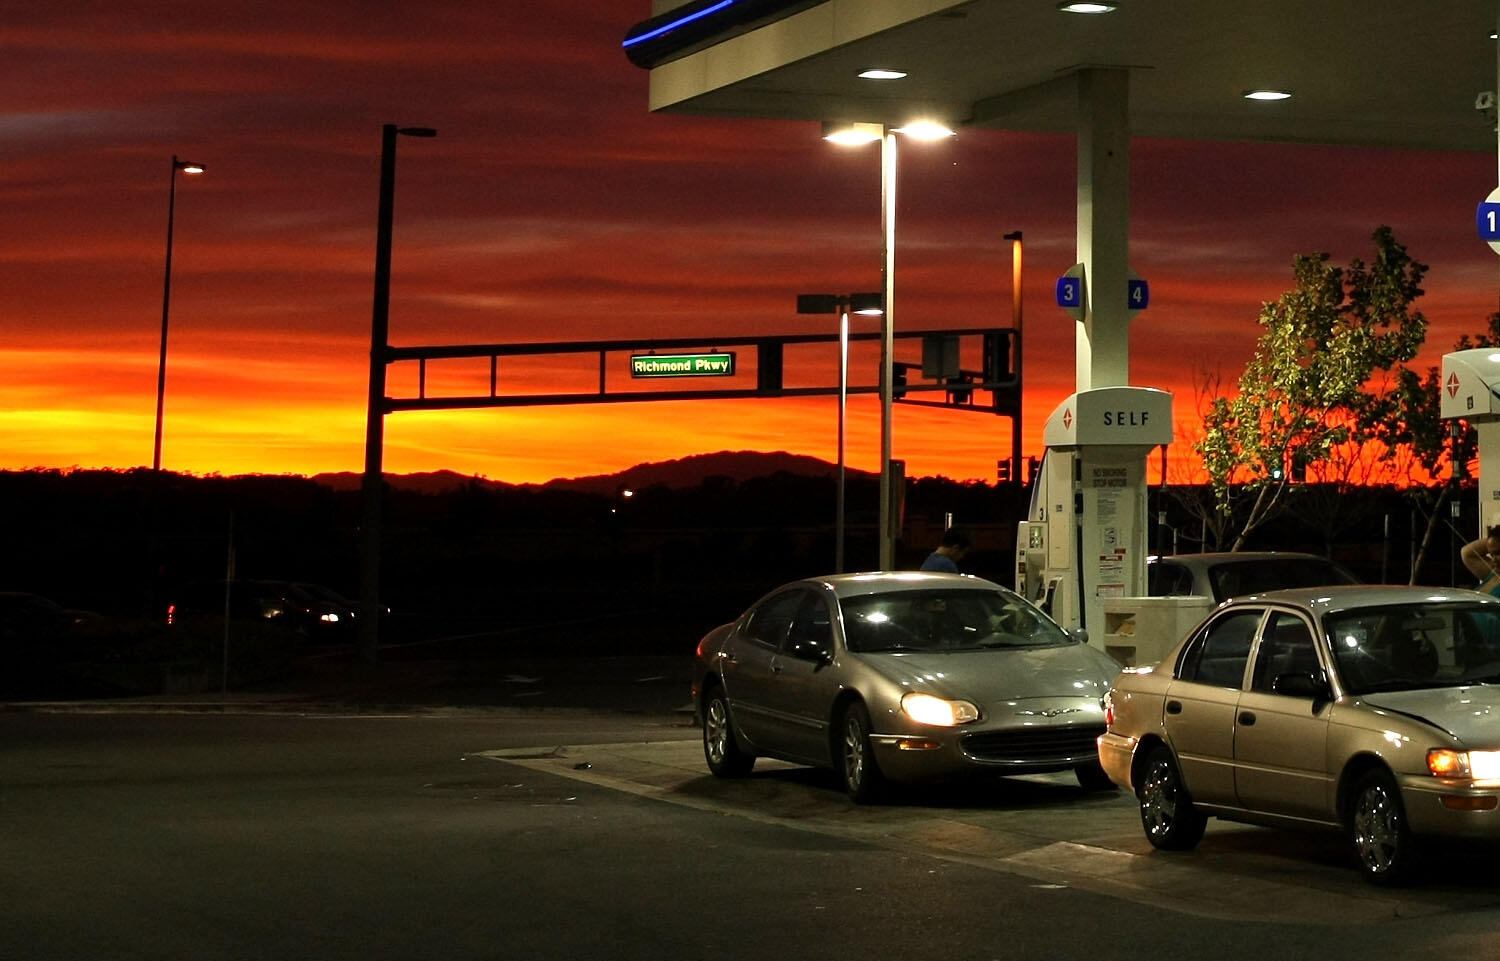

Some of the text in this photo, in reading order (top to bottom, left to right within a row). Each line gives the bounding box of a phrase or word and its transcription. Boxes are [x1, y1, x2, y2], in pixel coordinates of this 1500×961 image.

[1487, 210, 1496, 232] 1
[1063, 283, 1074, 301] 3
[1132, 286, 1143, 302] 4
[634, 359, 728, 372] Richmond Pkwy
[1104, 411, 1149, 426] SELF
[1039, 508, 1044, 520] 3
